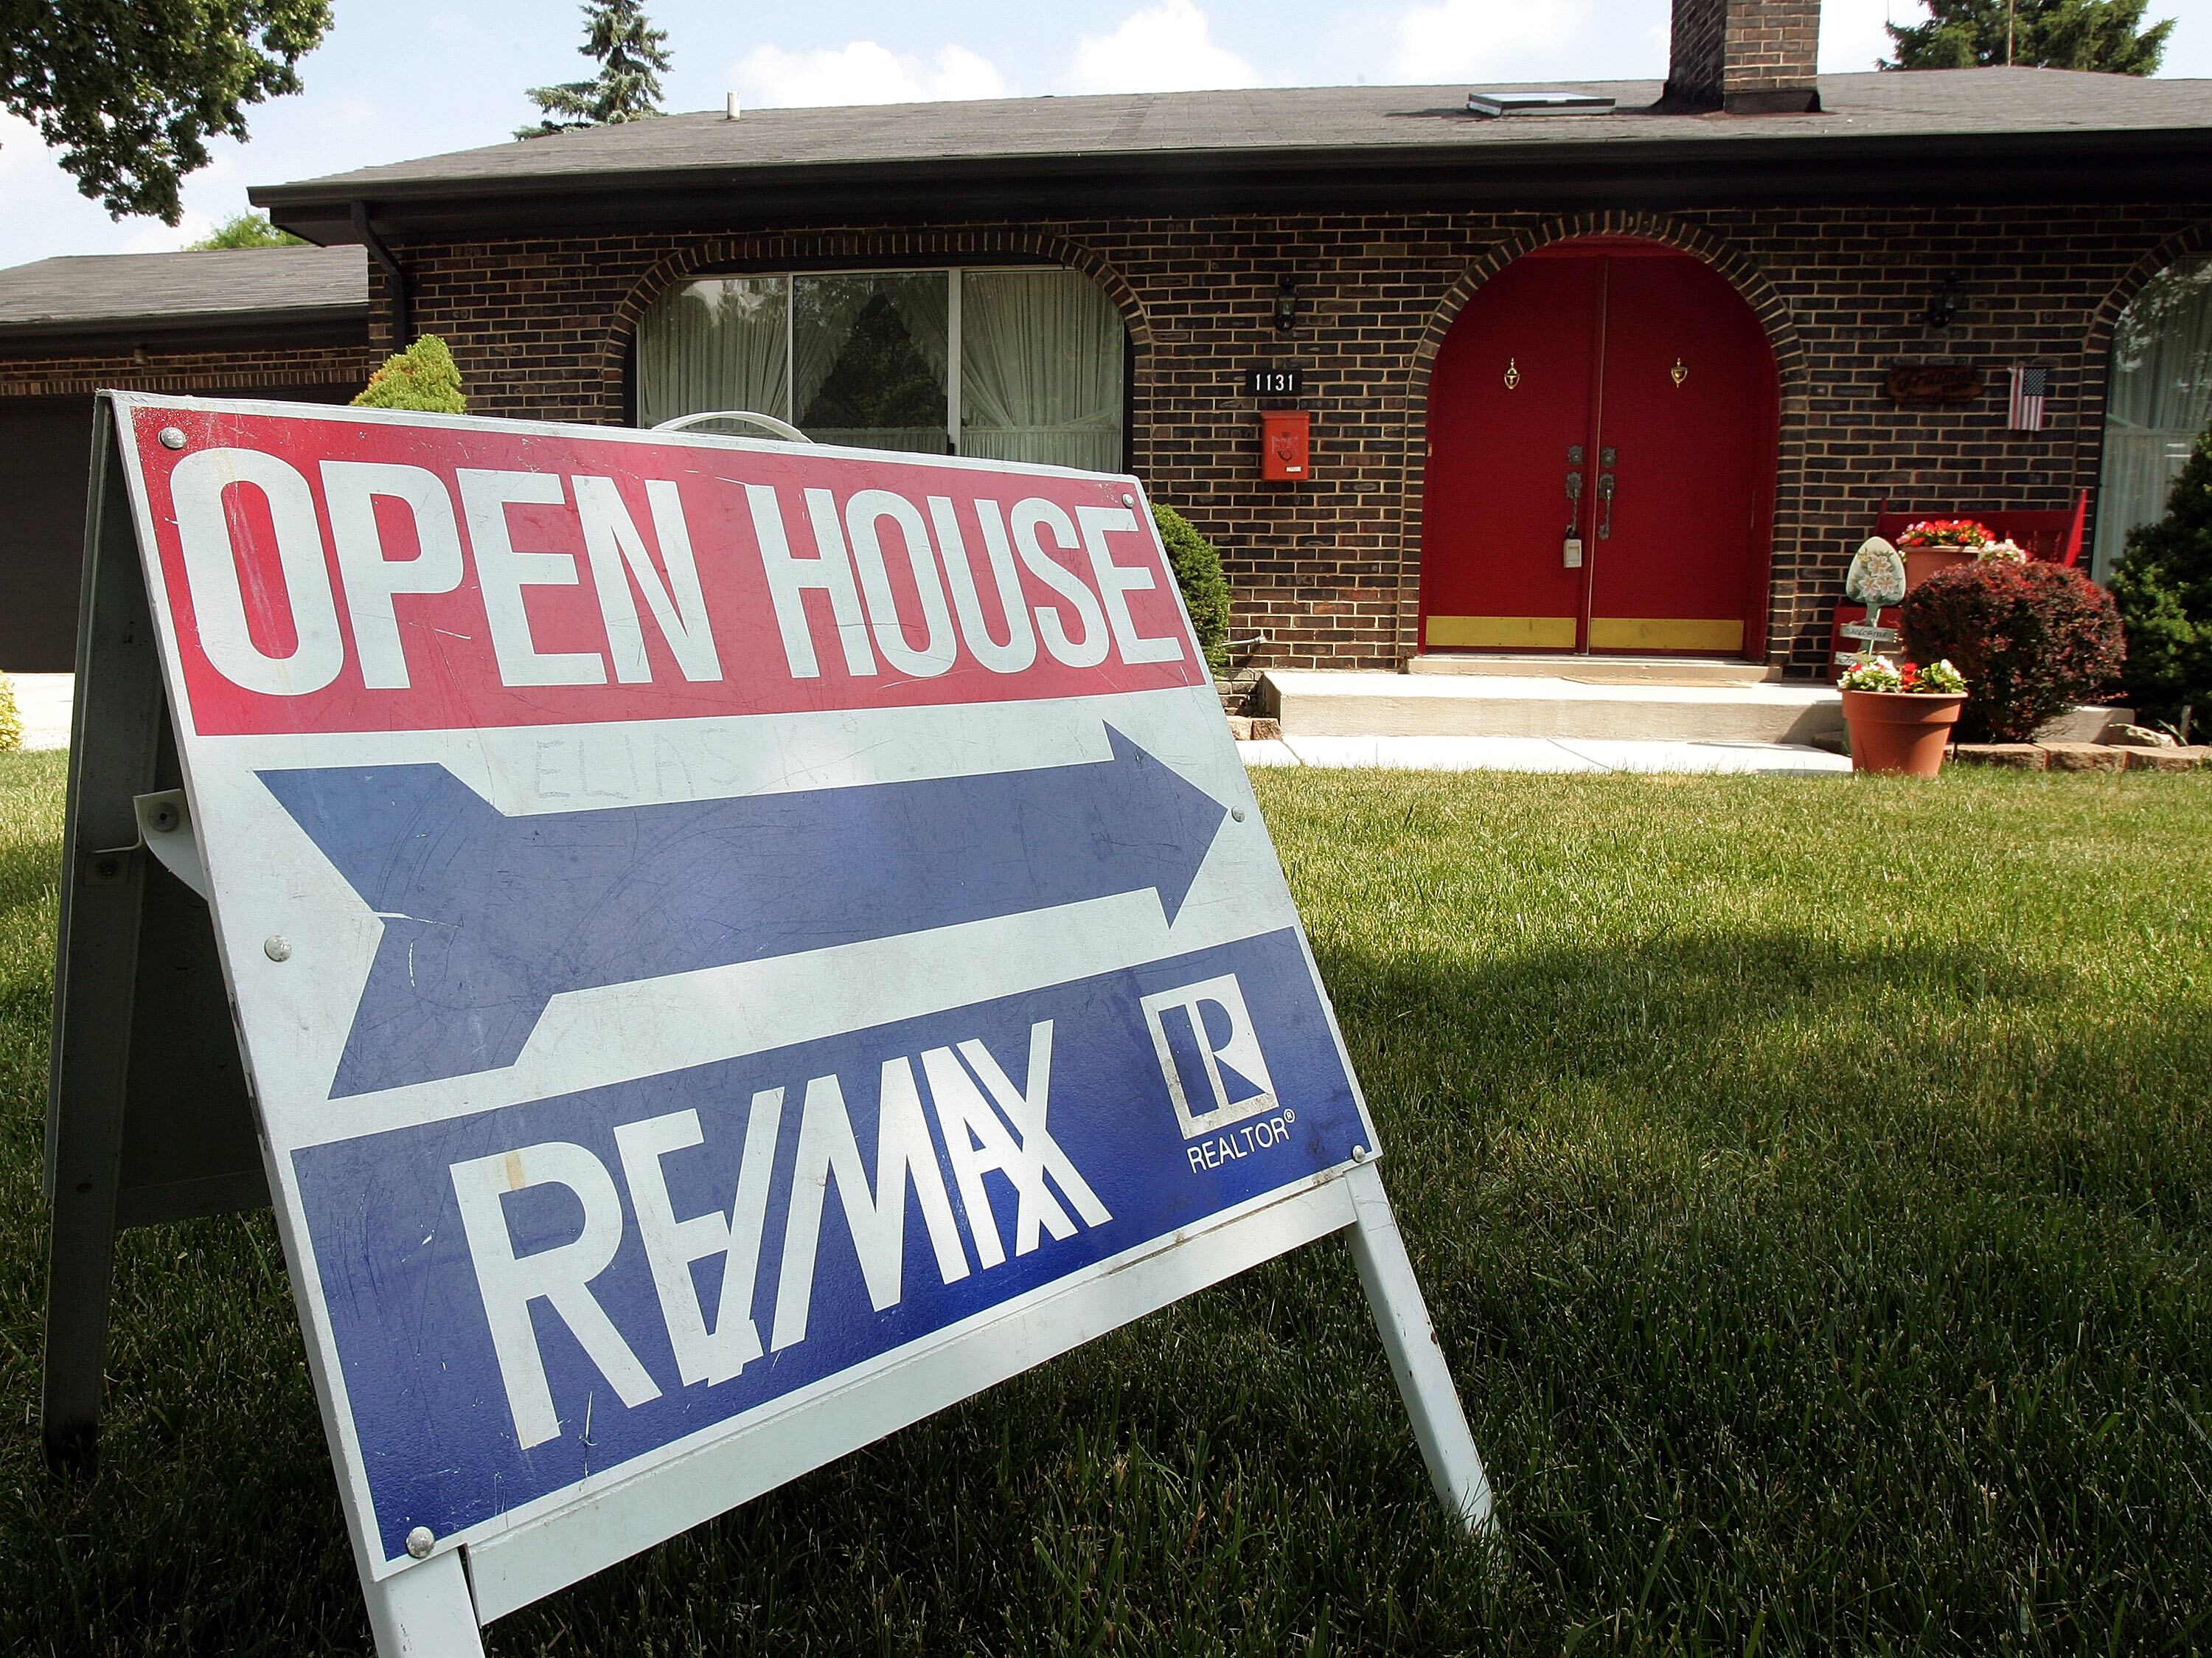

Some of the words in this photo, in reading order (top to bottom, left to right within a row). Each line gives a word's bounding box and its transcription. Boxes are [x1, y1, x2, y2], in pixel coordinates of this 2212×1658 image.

[1256, 373, 1293, 391] 1131
[170, 447, 723, 696] OPEN
[744, 484, 1185, 679] HOUSE
[534, 726, 740, 799] ELIAS
[448, 1019, 1113, 1451] RE/MAX
